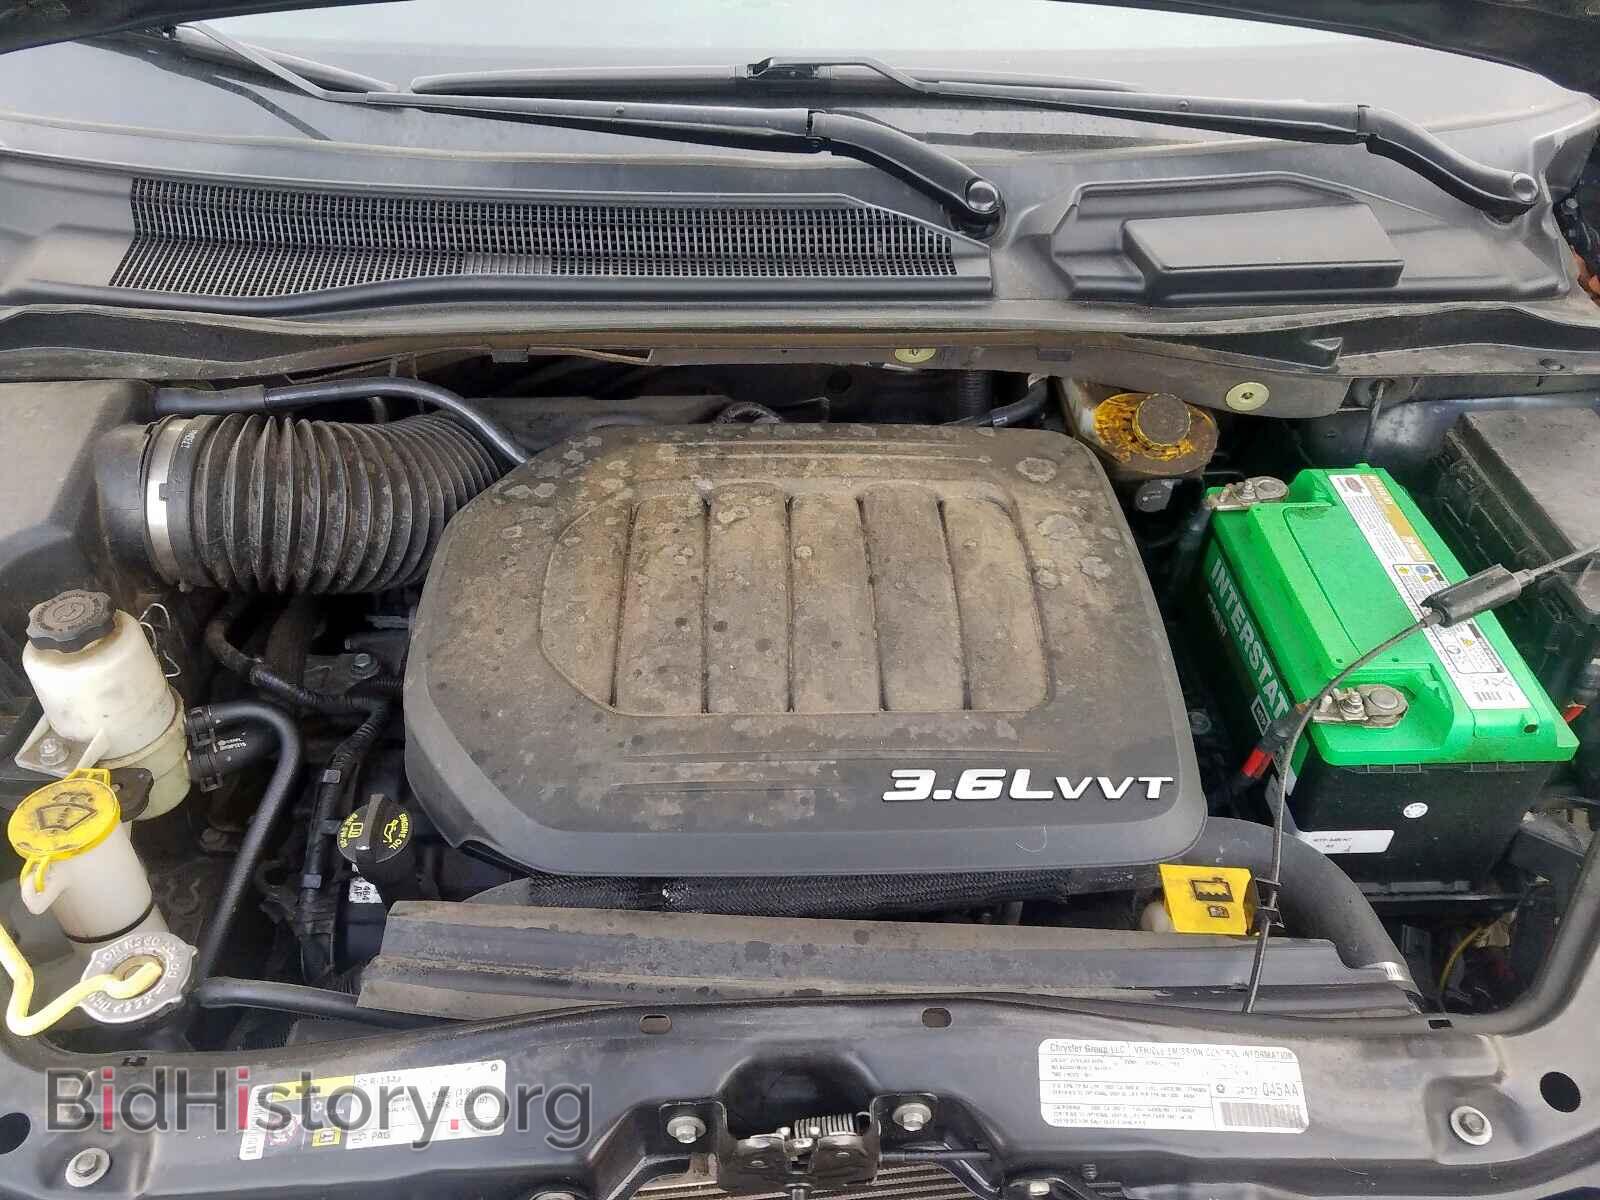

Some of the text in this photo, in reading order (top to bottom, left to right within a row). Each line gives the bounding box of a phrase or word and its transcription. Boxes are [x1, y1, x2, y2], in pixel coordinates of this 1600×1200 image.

[1211, 557, 1290, 721] INTERSTAT
[882, 768, 1174, 801] 3.6L VVT
[389, 813, 409, 850] ENGINE OIL
[1049, 1042, 1082, 1055] Chrysler
[1084, 1044, 1109, 1056] Group
